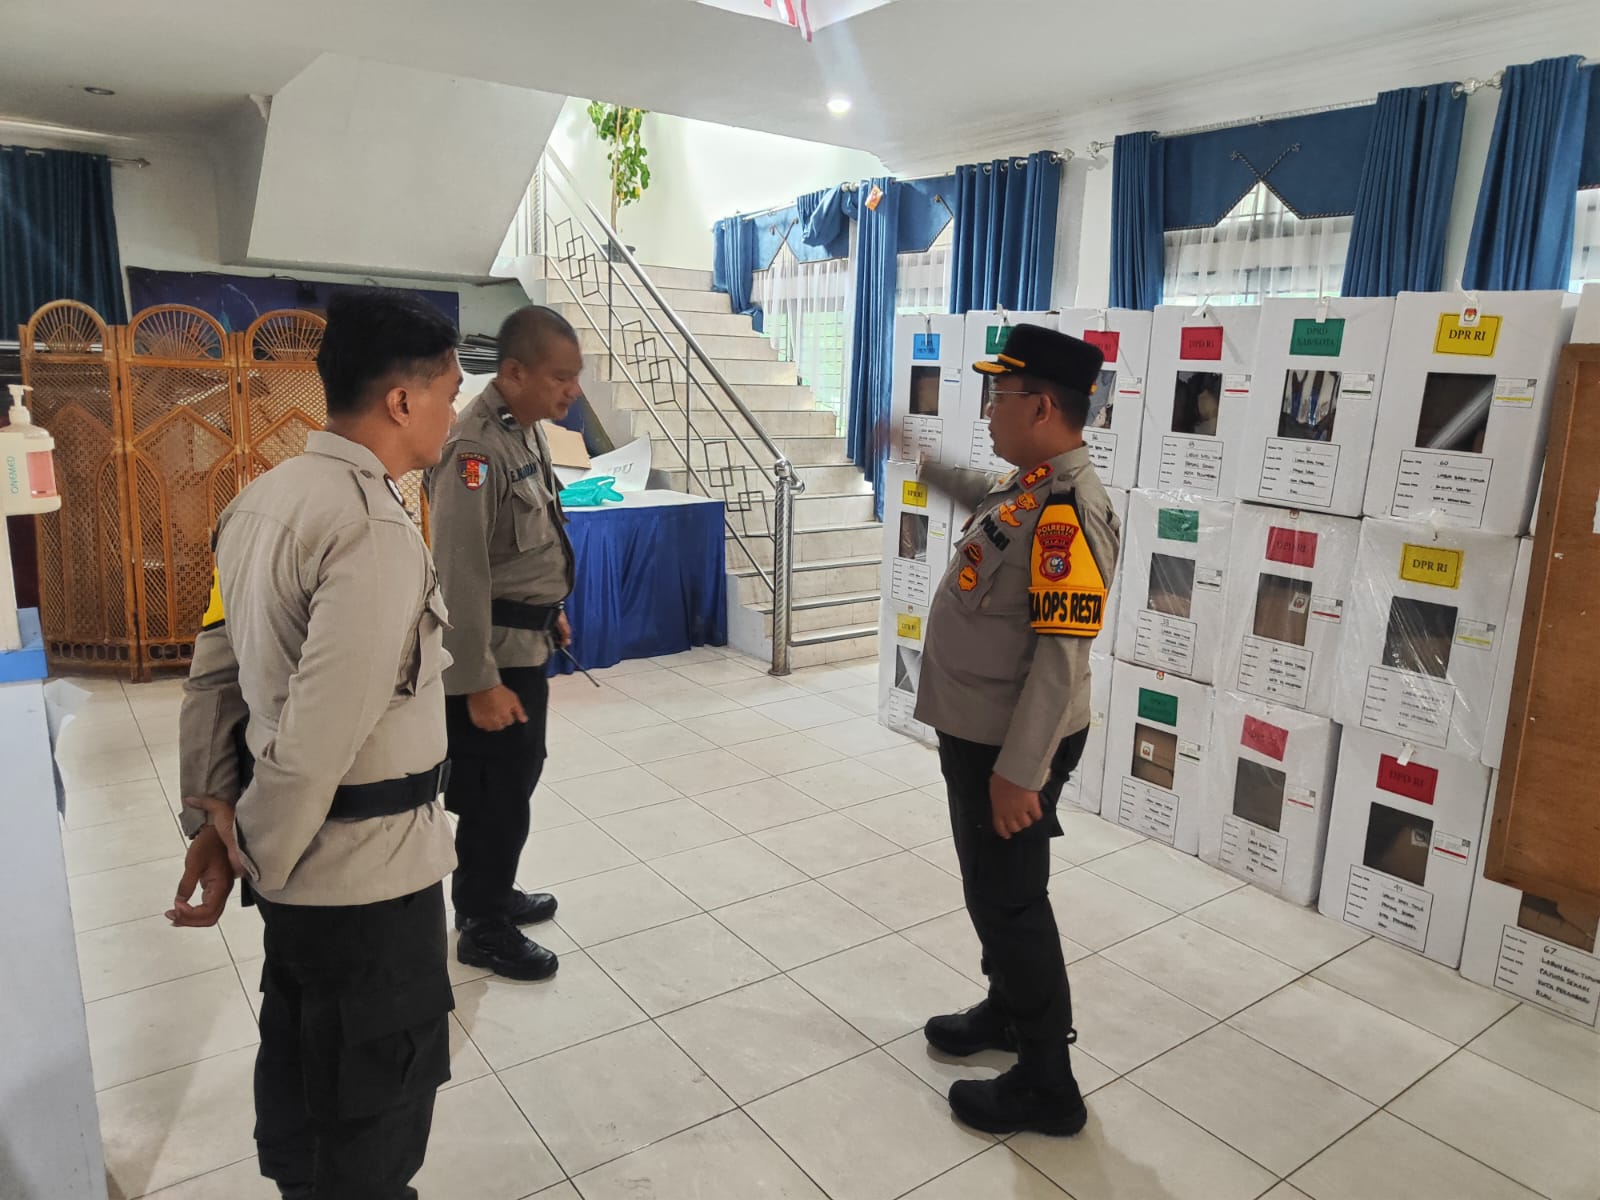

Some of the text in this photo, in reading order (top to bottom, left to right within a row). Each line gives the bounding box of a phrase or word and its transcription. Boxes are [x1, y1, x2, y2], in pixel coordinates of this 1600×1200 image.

[1449, 329, 1486, 341] DPR RI
[7, 456, 19, 494] ONEMED
[1036, 524, 1074, 535] POLRESTA
[1412, 559, 1448, 573] DPR RI
[1042, 591, 1068, 622] OPS
[1070, 593, 1102, 624] RESTA
[1543, 944, 1558, 955] 67
